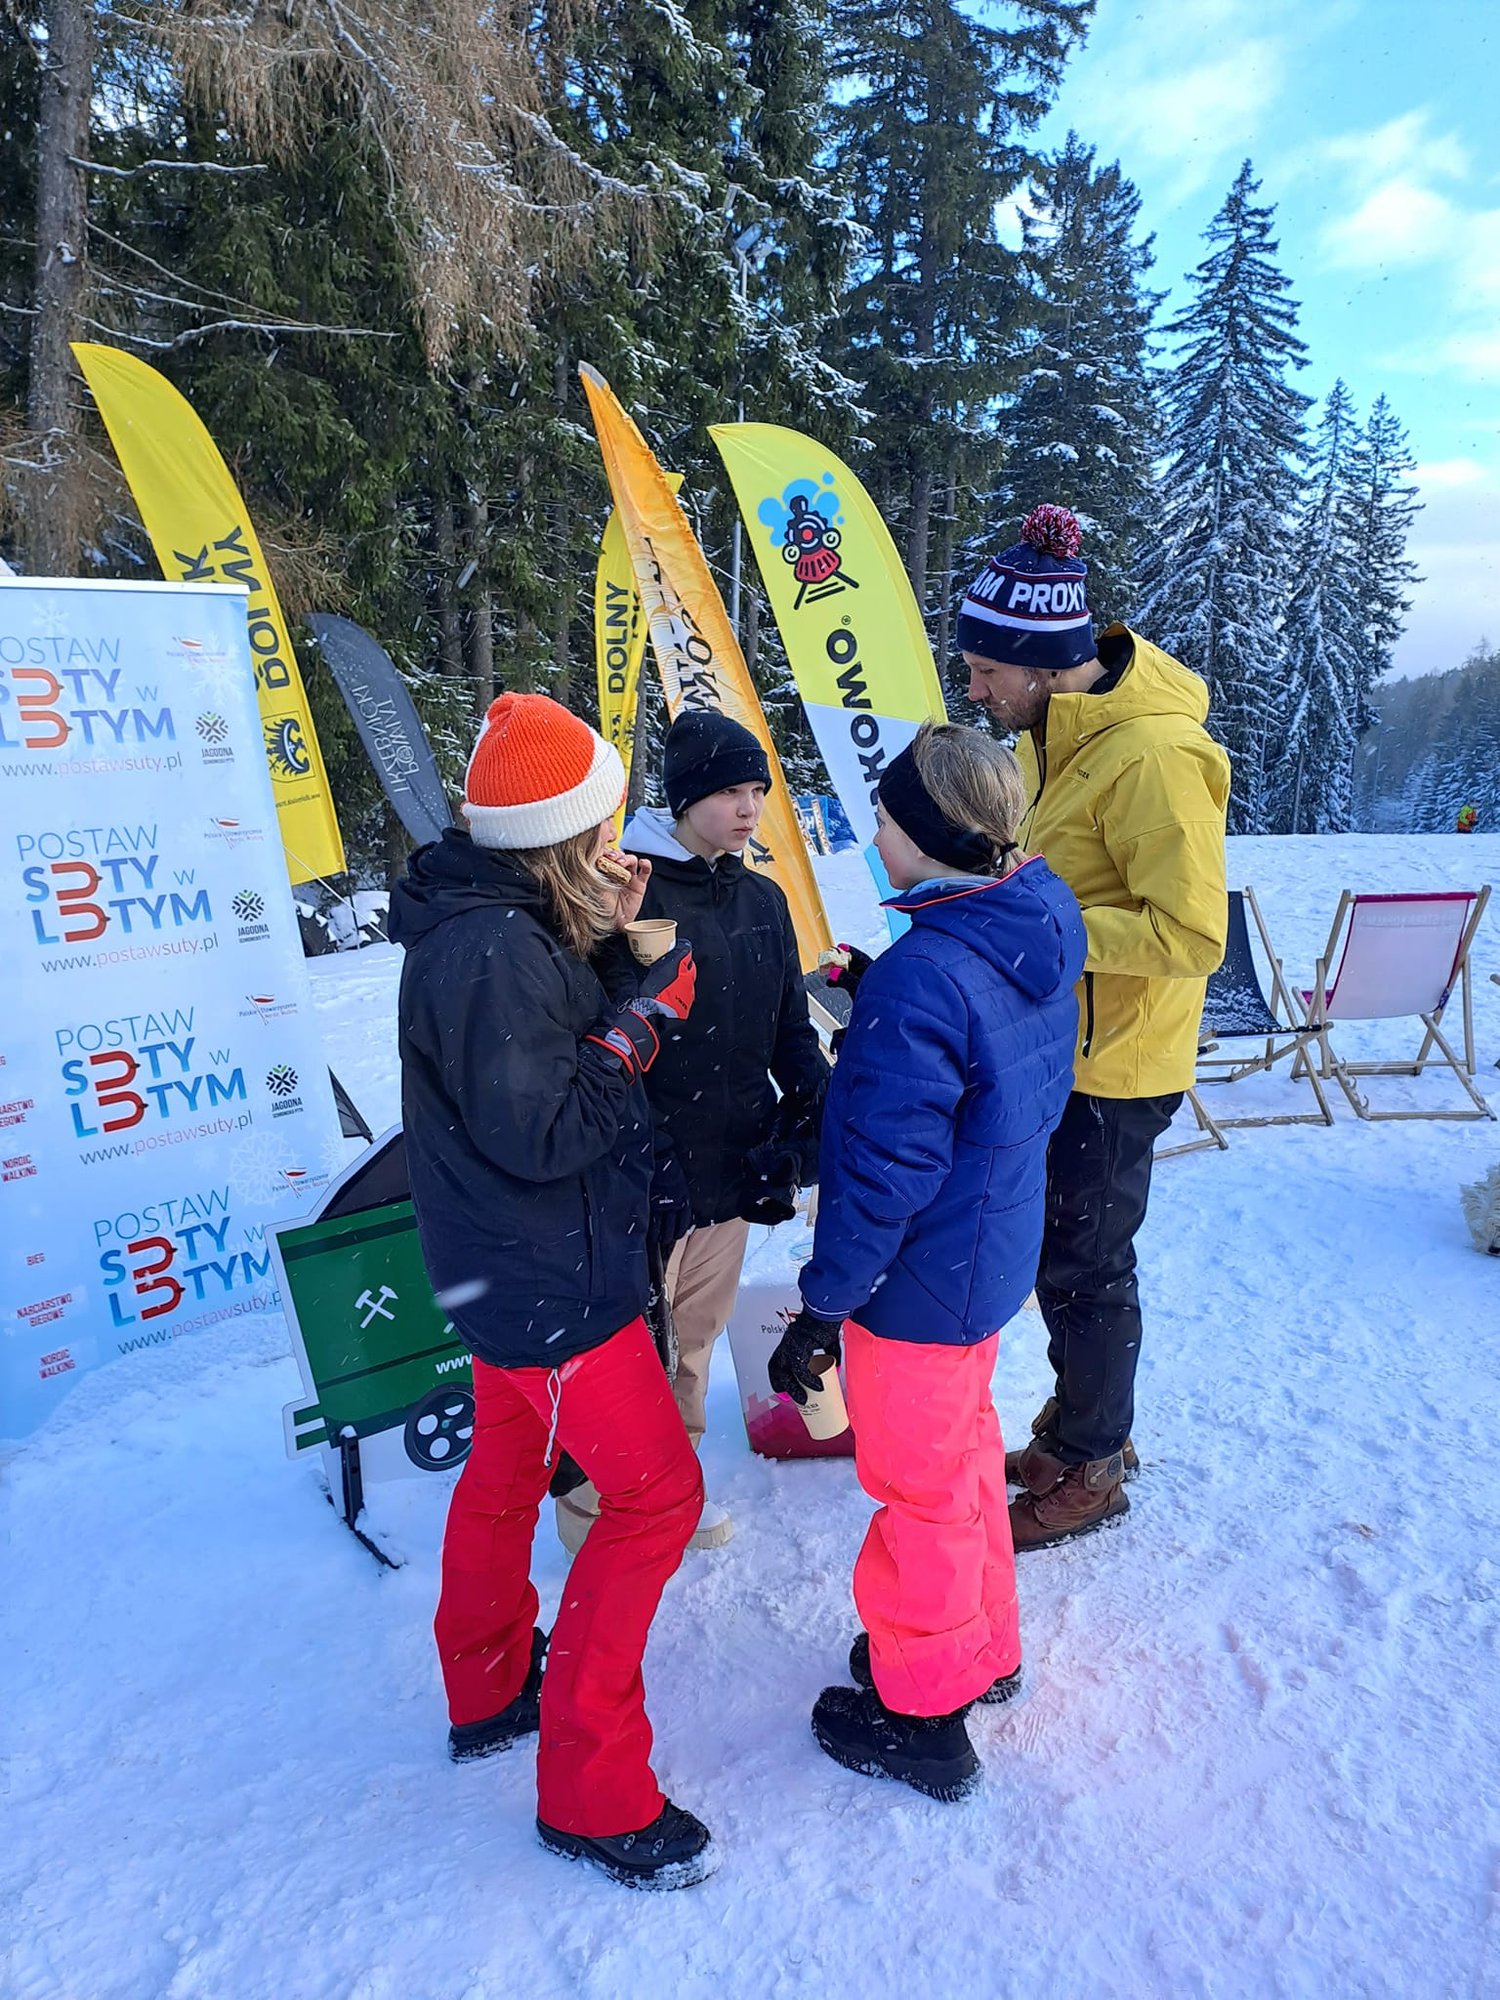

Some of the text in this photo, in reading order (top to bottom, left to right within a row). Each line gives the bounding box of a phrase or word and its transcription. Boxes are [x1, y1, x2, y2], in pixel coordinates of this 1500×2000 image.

[606, 581, 628, 693] DOLNY
[2, 752, 182, 778] www.postawsuty.pl
[16, 824, 158, 861] POSTAW
[41, 933, 219, 974] www.postawsuty.pl
[55, 1006, 194, 1056] POSTAW
[79, 1111, 253, 1165] www.postawsuty.pl
[1, 1165, 37, 1182] WALKING
[3, 1154, 32, 1169] NORDIC
[94, 1186, 229, 1246] POSTAW
[117, 1291, 281, 1355] www.postawsuty.p
